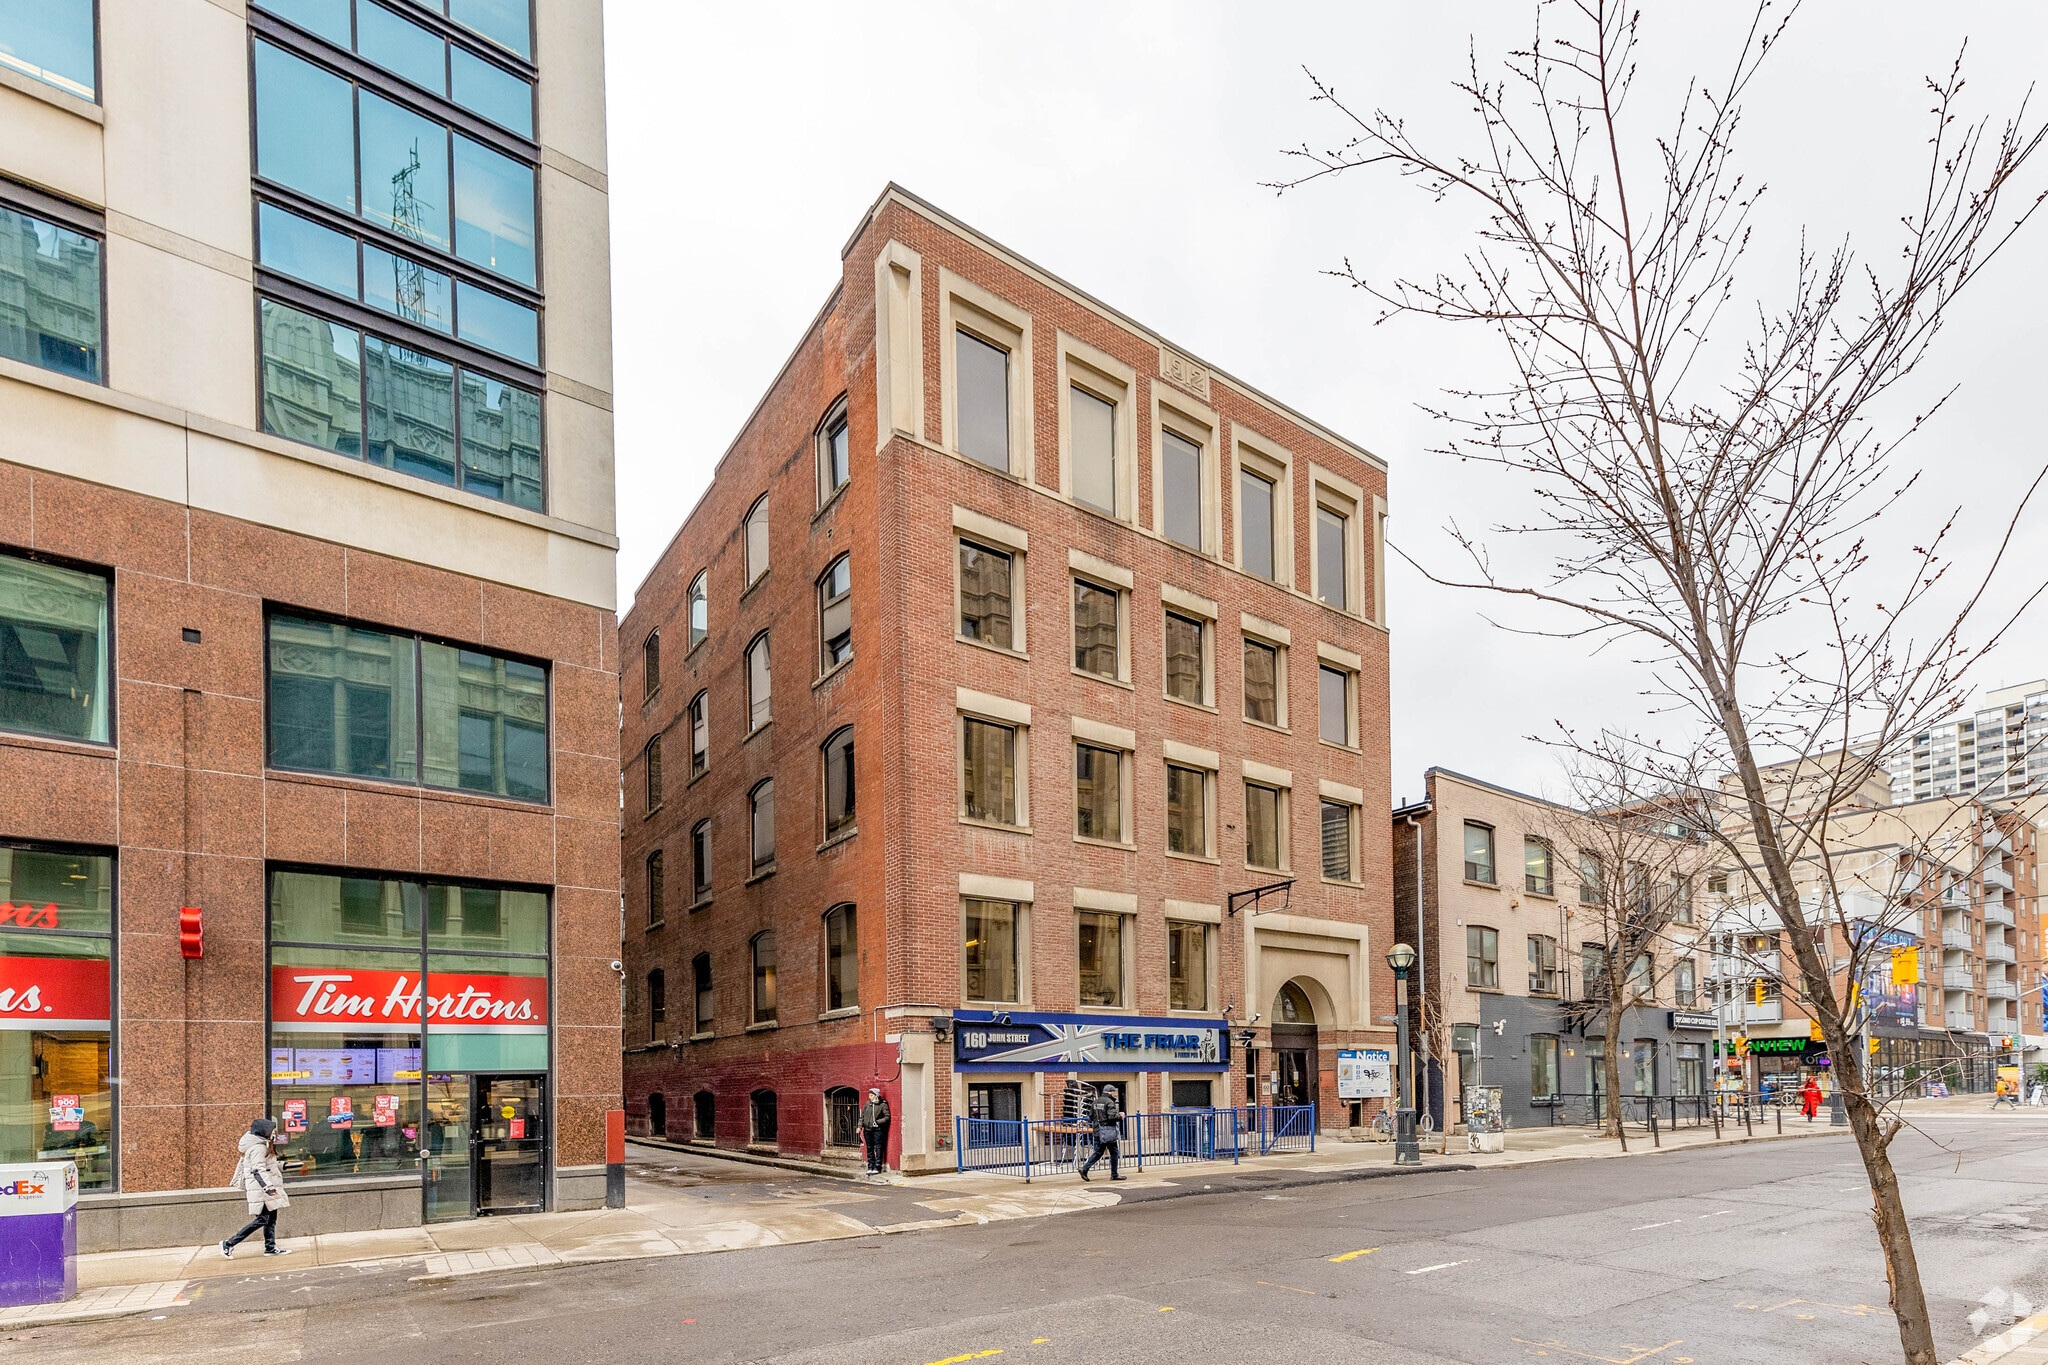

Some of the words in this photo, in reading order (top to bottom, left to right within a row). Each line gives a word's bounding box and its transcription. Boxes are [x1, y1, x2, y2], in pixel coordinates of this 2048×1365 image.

[293, 974, 376, 1017] Tim
[963, 1032, 987, 1049] 160
[987, 1033, 1006, 1043] JOHN
[1006, 1034, 1029, 1043] STREET
[1101, 1032, 1142, 1049] THE
[1144, 1034, 1200, 1050] FRIAR
[1356, 1050, 1388, 1061] Notice
